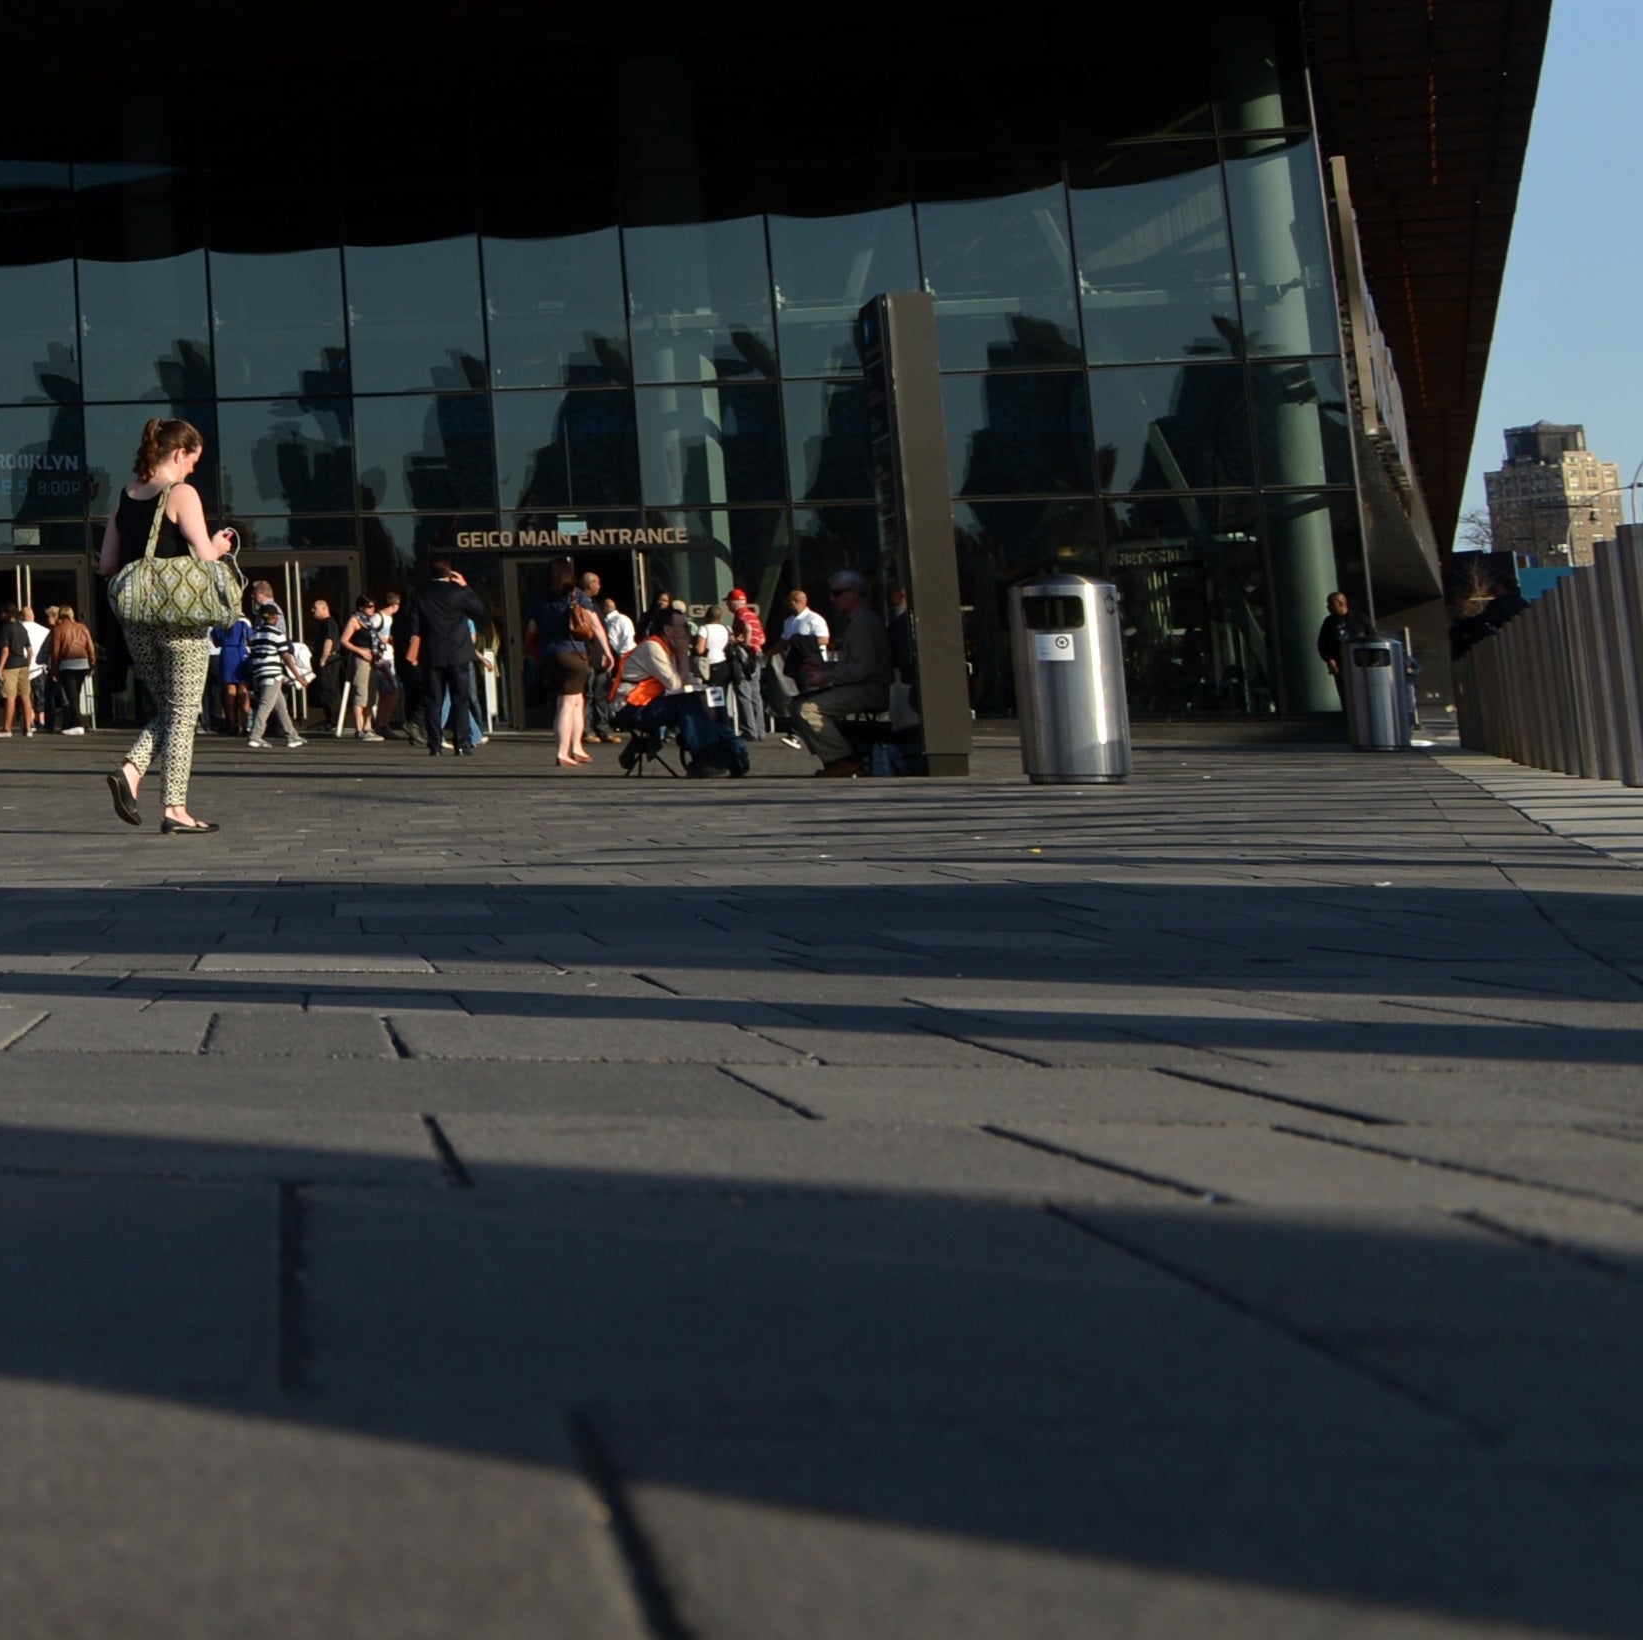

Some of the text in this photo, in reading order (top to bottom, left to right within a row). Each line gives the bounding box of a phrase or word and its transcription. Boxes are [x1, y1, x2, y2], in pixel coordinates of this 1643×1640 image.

[456, 527, 689, 548] GEICO MAIN ENTRANCE
